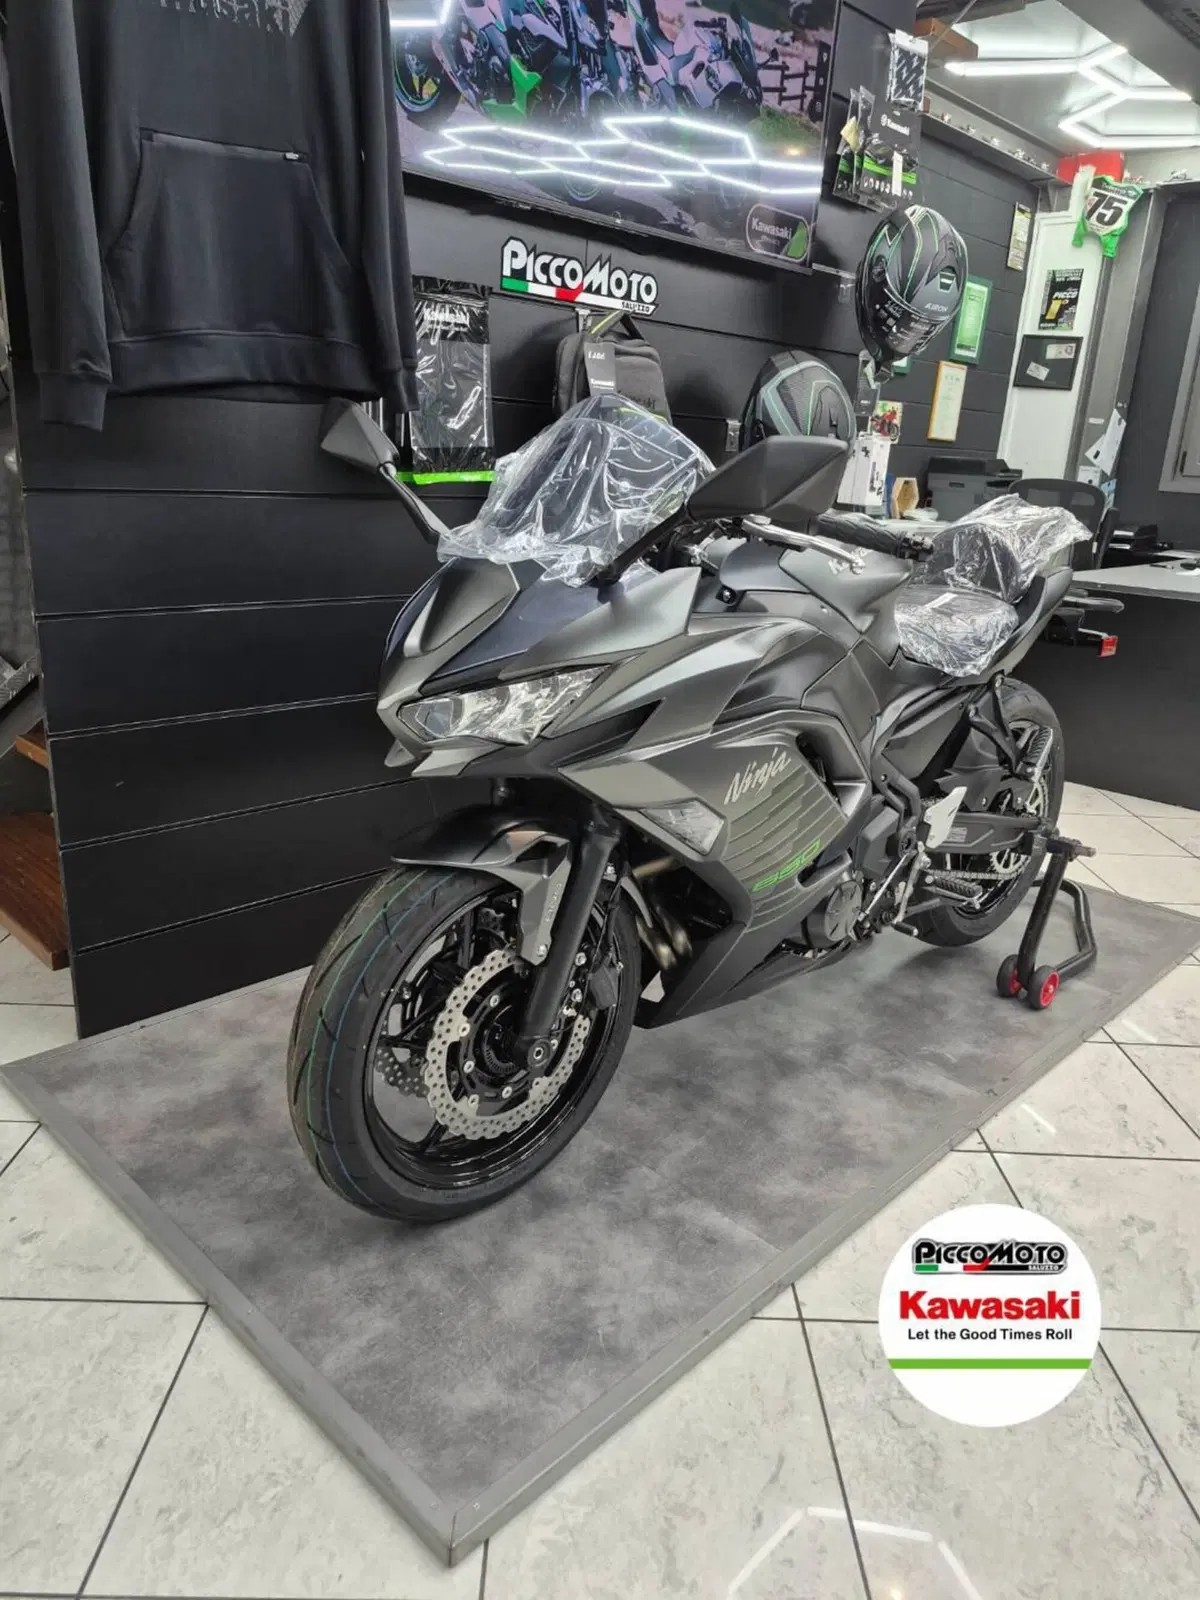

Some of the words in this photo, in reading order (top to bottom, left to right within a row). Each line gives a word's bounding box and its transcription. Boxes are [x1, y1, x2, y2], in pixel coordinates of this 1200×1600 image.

[1086, 191, 1128, 226] 75
[751, 217, 792, 240] Kawasaki
[621, 301, 651, 313] SALUZZO
[724, 747, 791, 805] Ninja
[751, 839, 821, 892] 650
